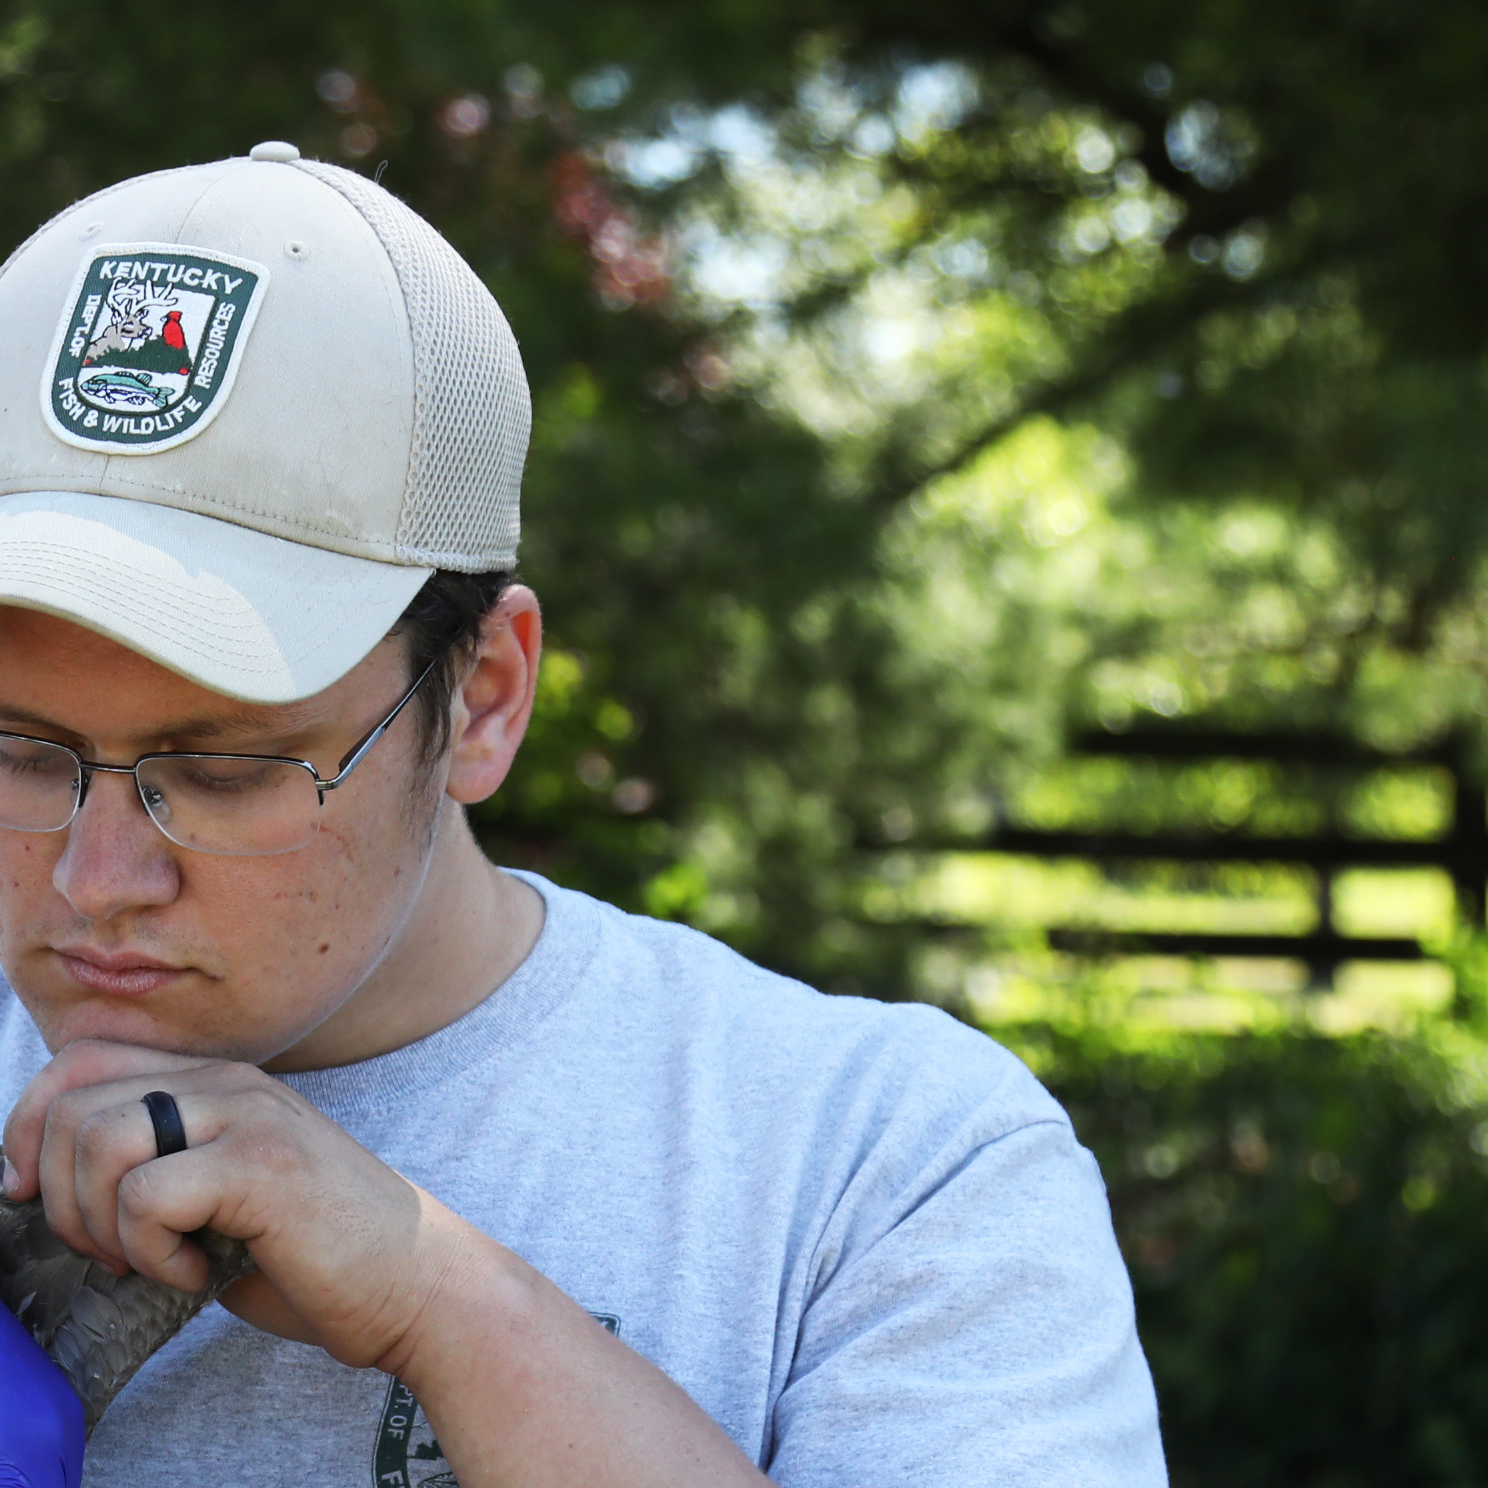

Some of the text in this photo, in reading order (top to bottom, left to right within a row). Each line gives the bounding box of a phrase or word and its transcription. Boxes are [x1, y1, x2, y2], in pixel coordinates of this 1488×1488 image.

[99, 260, 243, 295] KENTUCKY
[69, 337, 86, 358] OF
[194, 302, 236, 389] RESOURCES
[59, 377, 203, 435] FISH & WILDLIFE
[387, 1415, 408, 1440] OF
